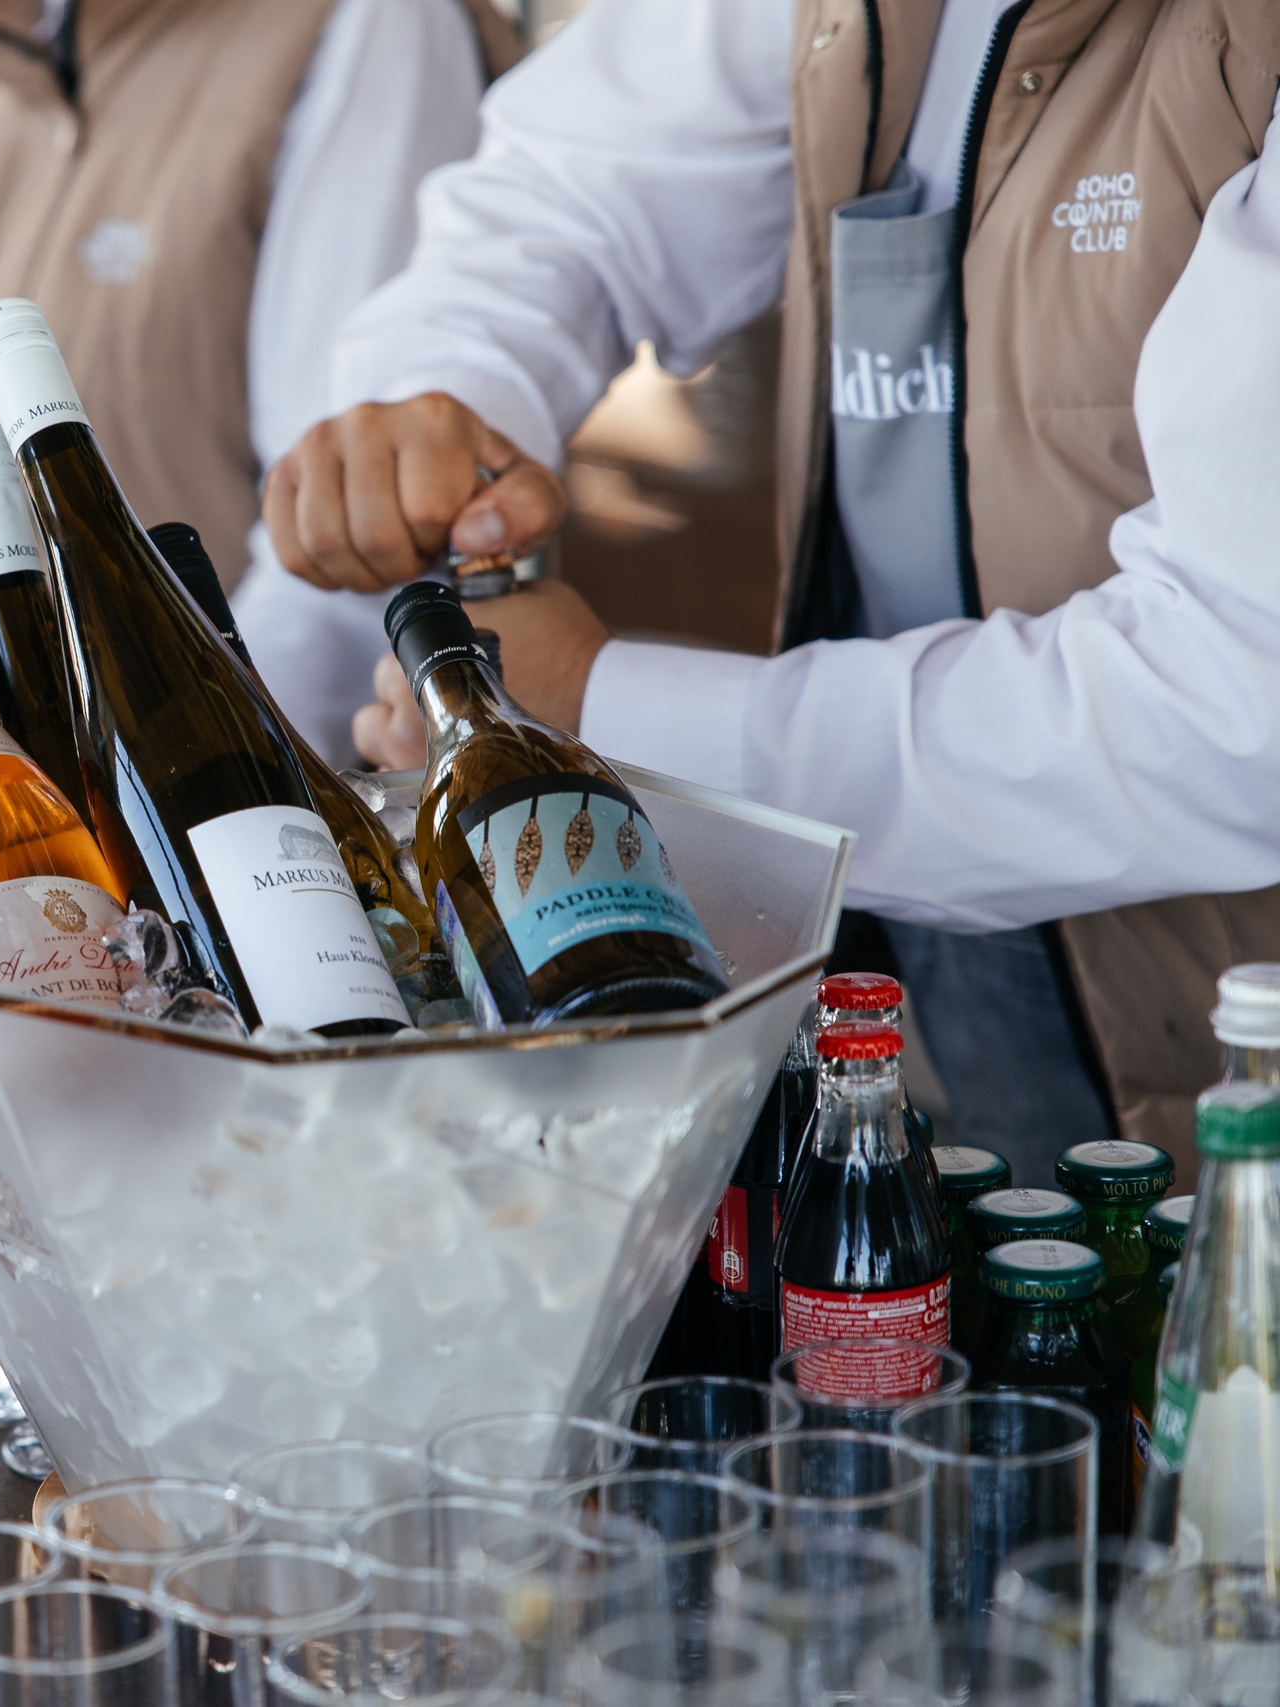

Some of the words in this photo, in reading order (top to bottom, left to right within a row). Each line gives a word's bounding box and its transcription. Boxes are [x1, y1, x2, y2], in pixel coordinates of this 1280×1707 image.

[1075, 171, 1135, 200] SOHO
[1070, 225, 1127, 253] CLUB
[28, 401, 79, 420] MARKUS
[418, 655, 433, 672] New
[433, 646, 468, 658] Zealand
[252, 868, 329, 891] MARKUS
[534, 886, 640, 921] PADDLE
[316, 950, 349, 964] Haus
[25, 980, 65, 998] ANT
[69, 978, 94, 993] DE
[1103, 1180, 1149, 1196] MOLTO
[988, 1276, 1010, 1294] CHE
[1014, 1282, 1067, 1299] BUONO
[923, 1305, 948, 1326] Coke
